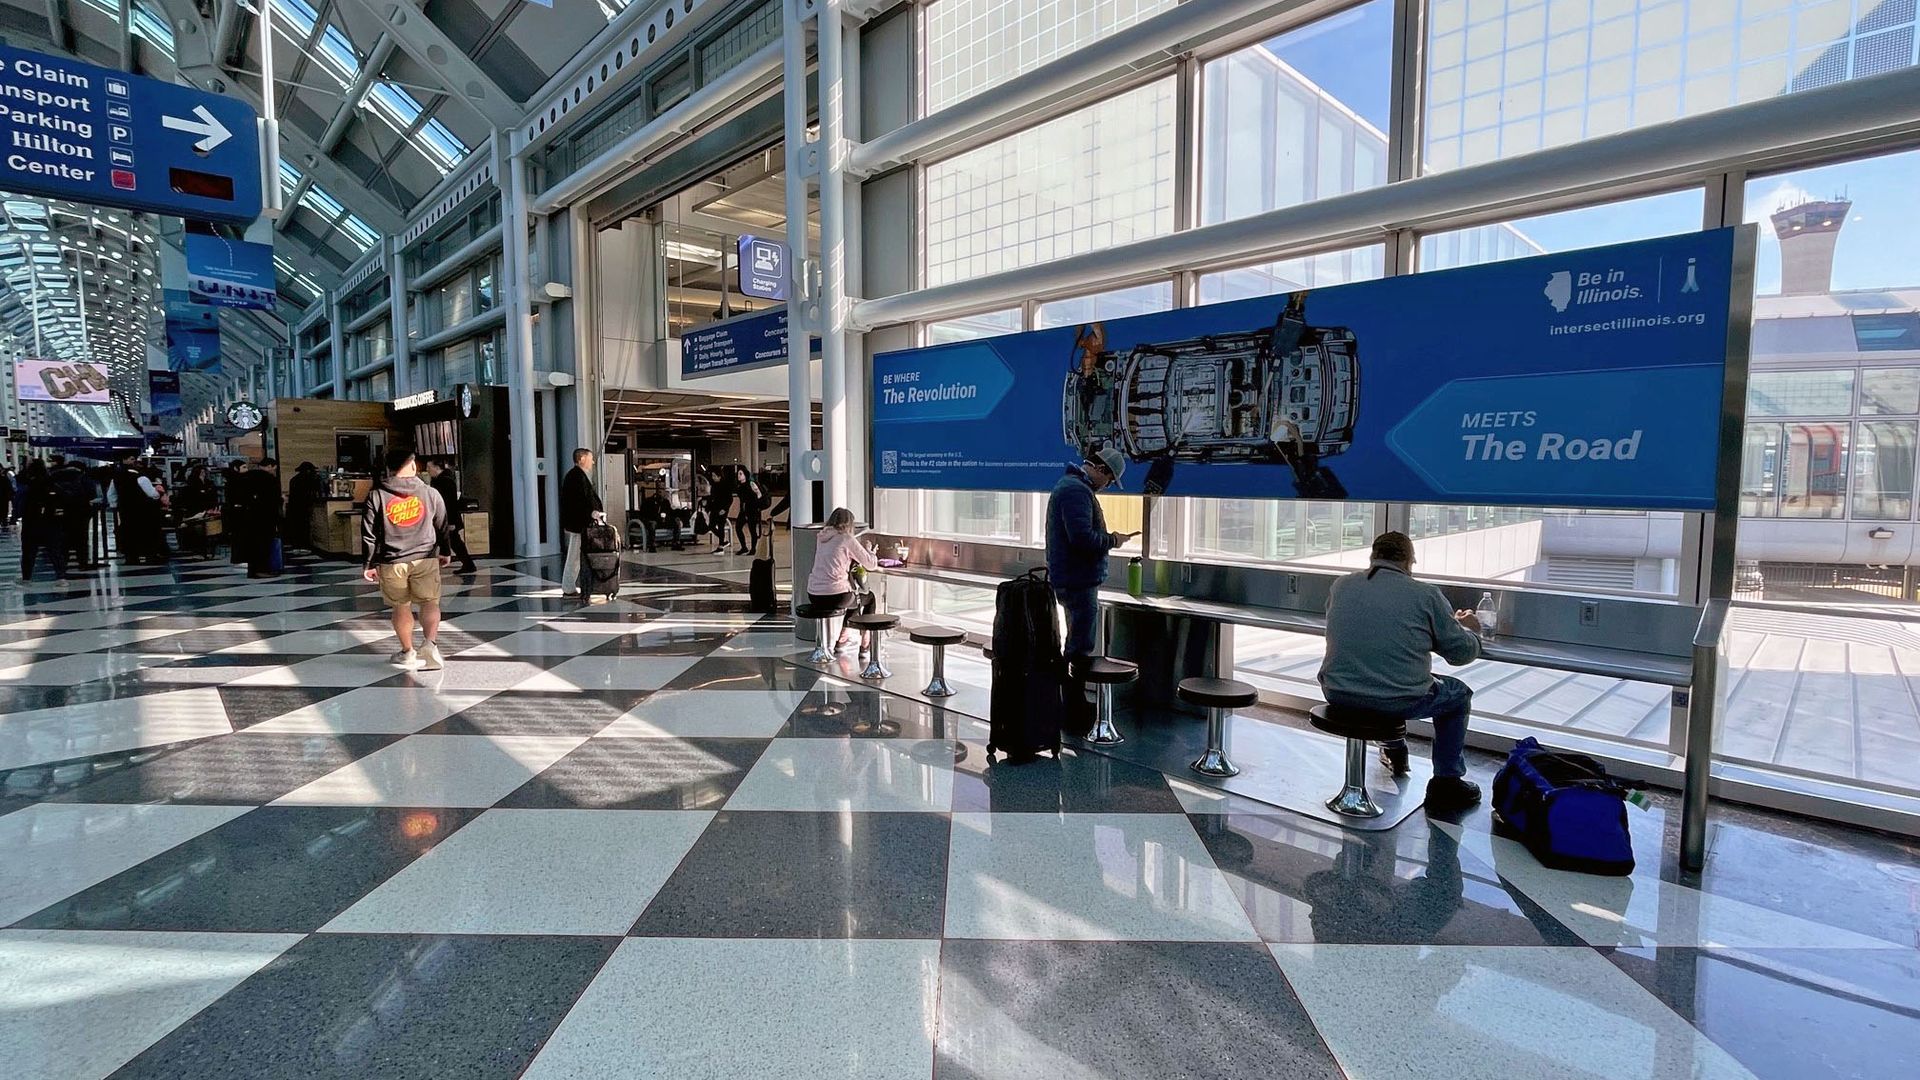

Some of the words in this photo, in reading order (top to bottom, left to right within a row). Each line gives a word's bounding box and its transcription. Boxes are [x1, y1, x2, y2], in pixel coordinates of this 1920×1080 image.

[15, 60, 89, 89] Claim
[12, 130, 94, 160] Hilton
[8, 154, 95, 182] Center
[752, 277, 777, 289] Charging
[752, 283, 772, 292] Station
[1577, 272, 1602, 287] Be
[1606, 268, 1625, 283] in
[1576, 285, 1644, 305] Illinois.
[1549, 313, 1706, 336] intersectillinois.org
[883, 374, 893, 384] BE
[894, 371, 921, 383] WHERE
[883, 388, 905, 405] The
[907, 382, 977, 403] Revolution
[1461, 411, 1537, 429] MEETS
[1462, 433, 1527, 461] The
[1536, 430, 1643, 461] Road
[386, 496, 420, 516] SANTA
[393, 507, 421, 525] CRUZ
